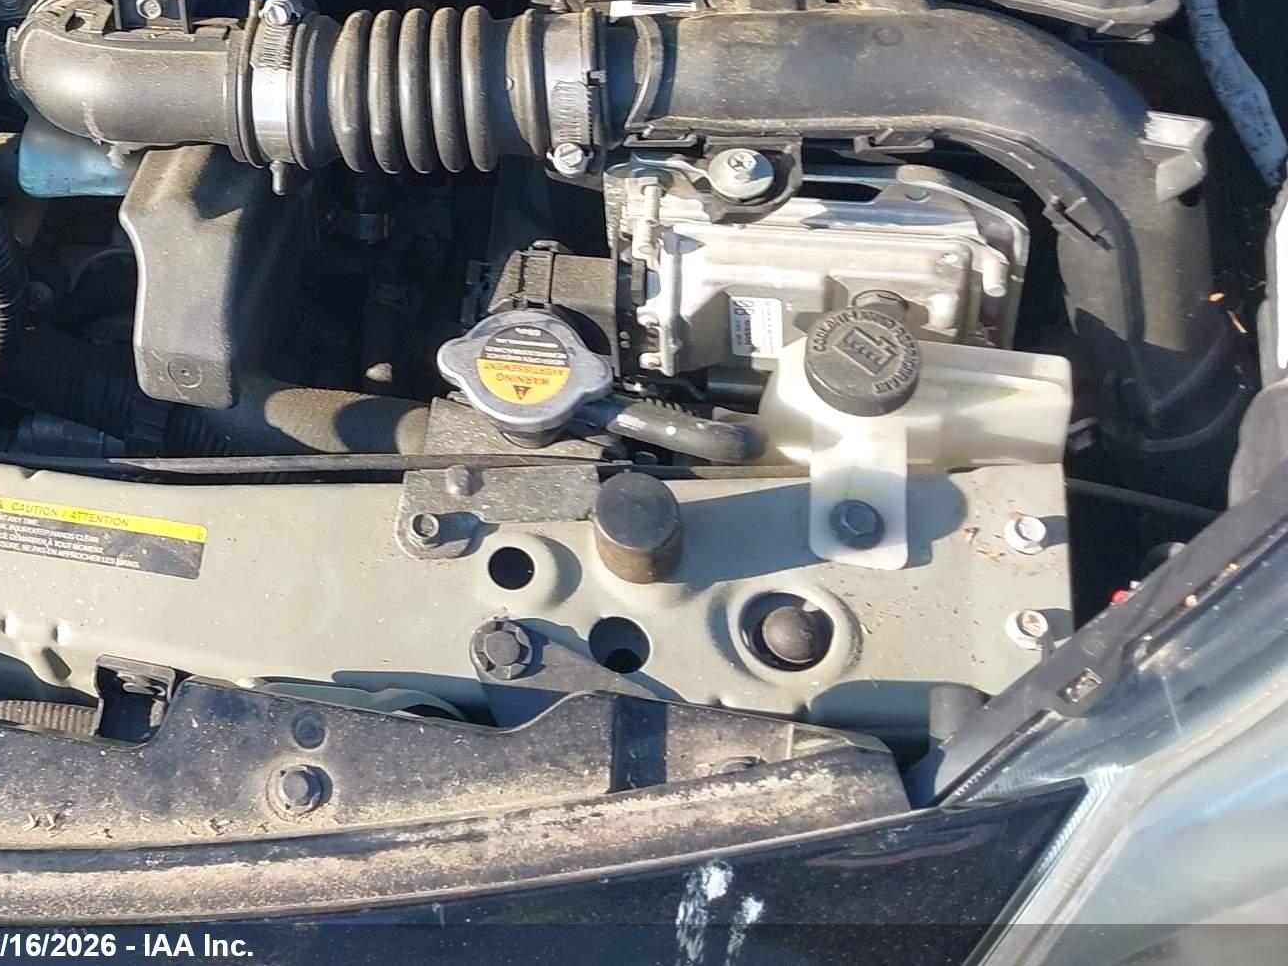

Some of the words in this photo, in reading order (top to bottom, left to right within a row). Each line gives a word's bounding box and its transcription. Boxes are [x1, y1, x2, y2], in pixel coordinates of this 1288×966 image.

[496, 372, 550, 385] WARNING
[11, 501, 58, 517] CAUTION
[71, 510, 129, 527] ATTENTION
